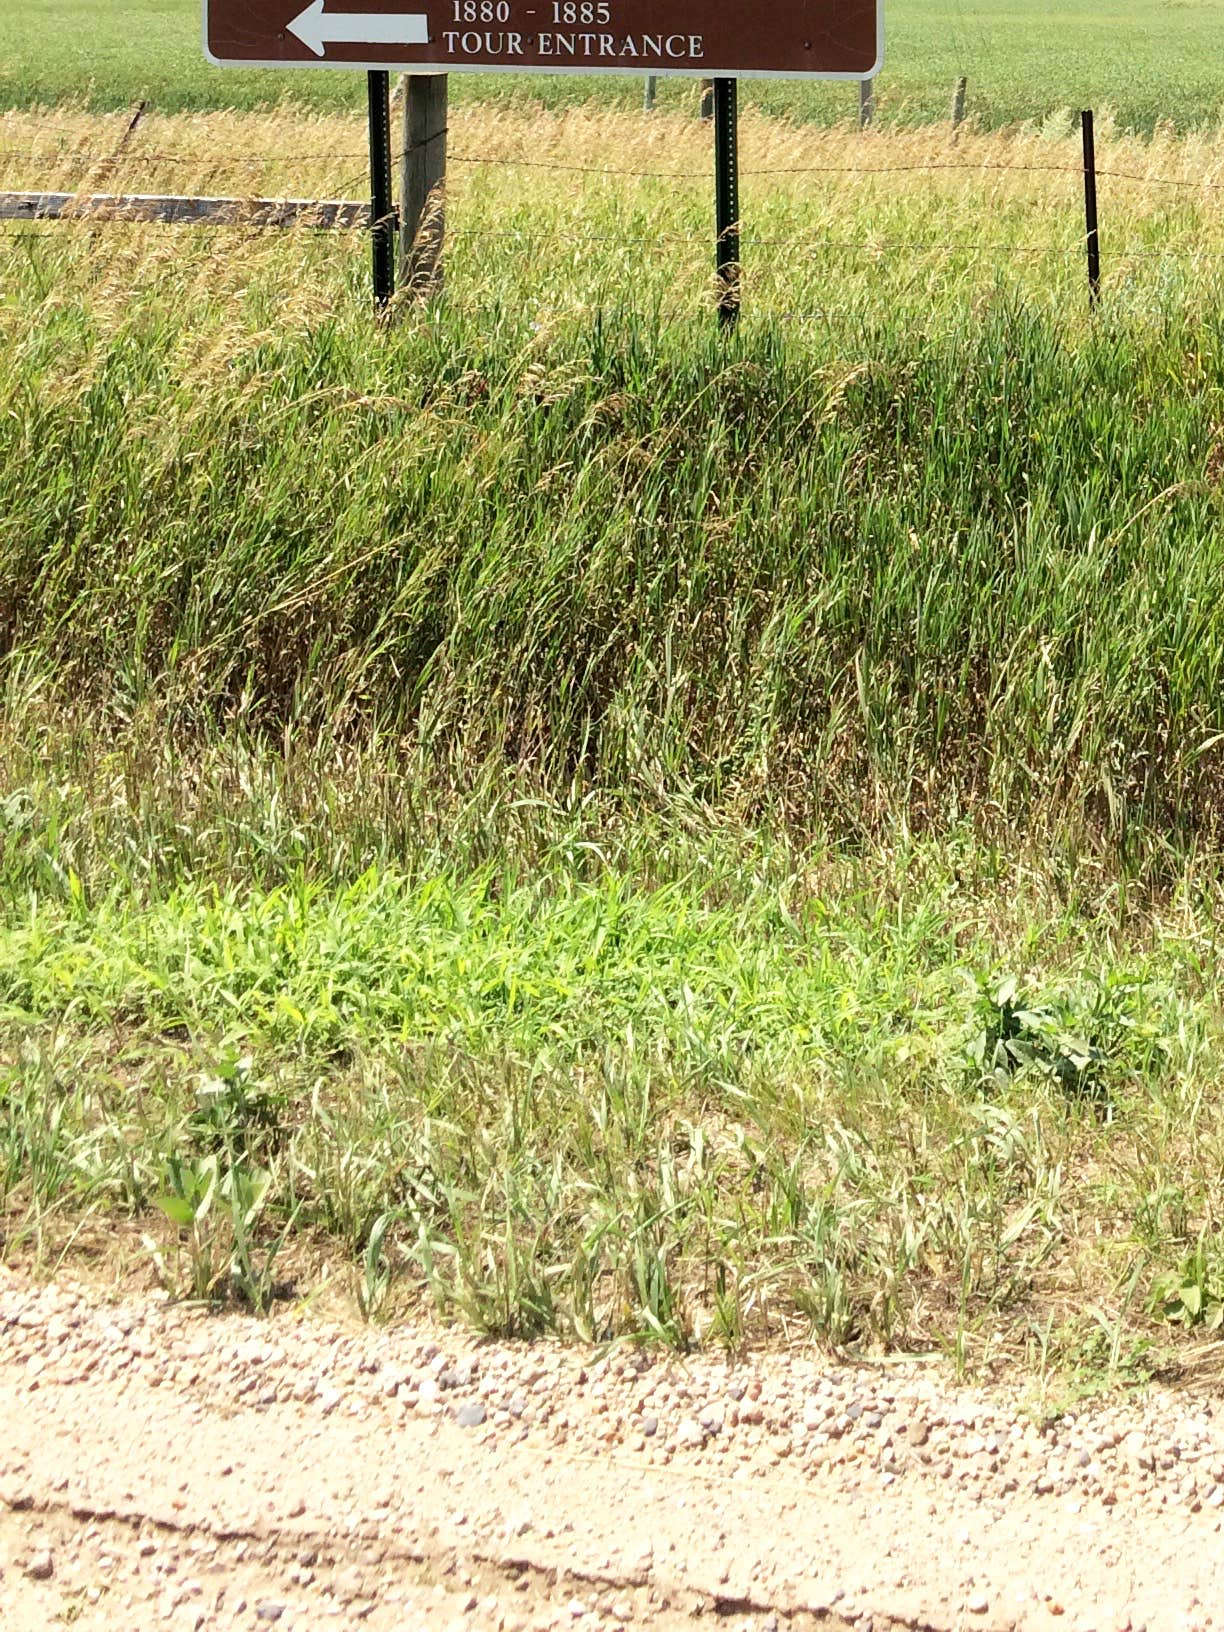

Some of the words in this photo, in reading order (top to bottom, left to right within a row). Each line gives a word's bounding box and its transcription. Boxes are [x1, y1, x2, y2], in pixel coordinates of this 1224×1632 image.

[453, 0, 510, 23] 1880
[552, 1, 610, 25] 1885
[442, 31, 524, 55] TOUR
[538, 33, 704, 58] ENTRANCE
